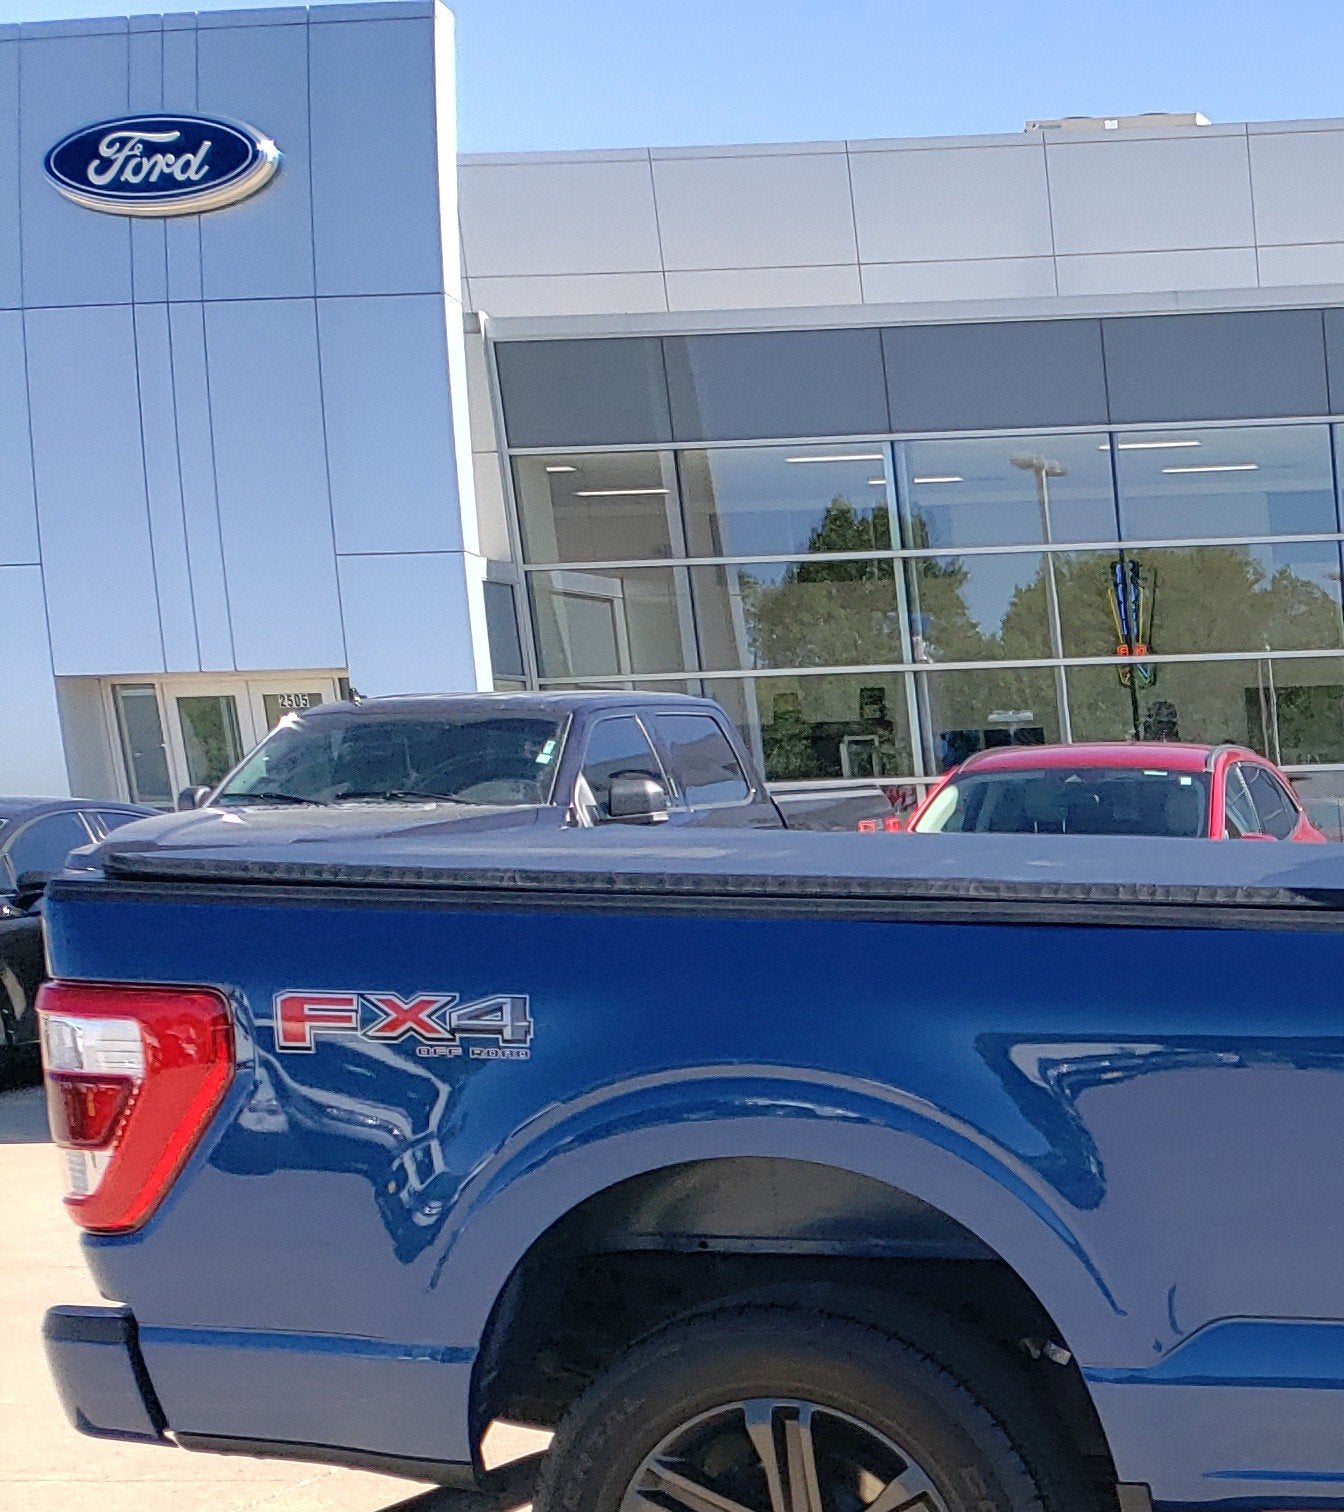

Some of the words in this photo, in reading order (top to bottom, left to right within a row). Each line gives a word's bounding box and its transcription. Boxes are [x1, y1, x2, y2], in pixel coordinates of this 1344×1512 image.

[86, 129, 212, 186] Ford
[279, 693, 309, 707] 2505
[272, 988, 534, 1054] FX4
[415, 1046, 462, 1058] OFF
[469, 1046, 531, 1059] ROAD
